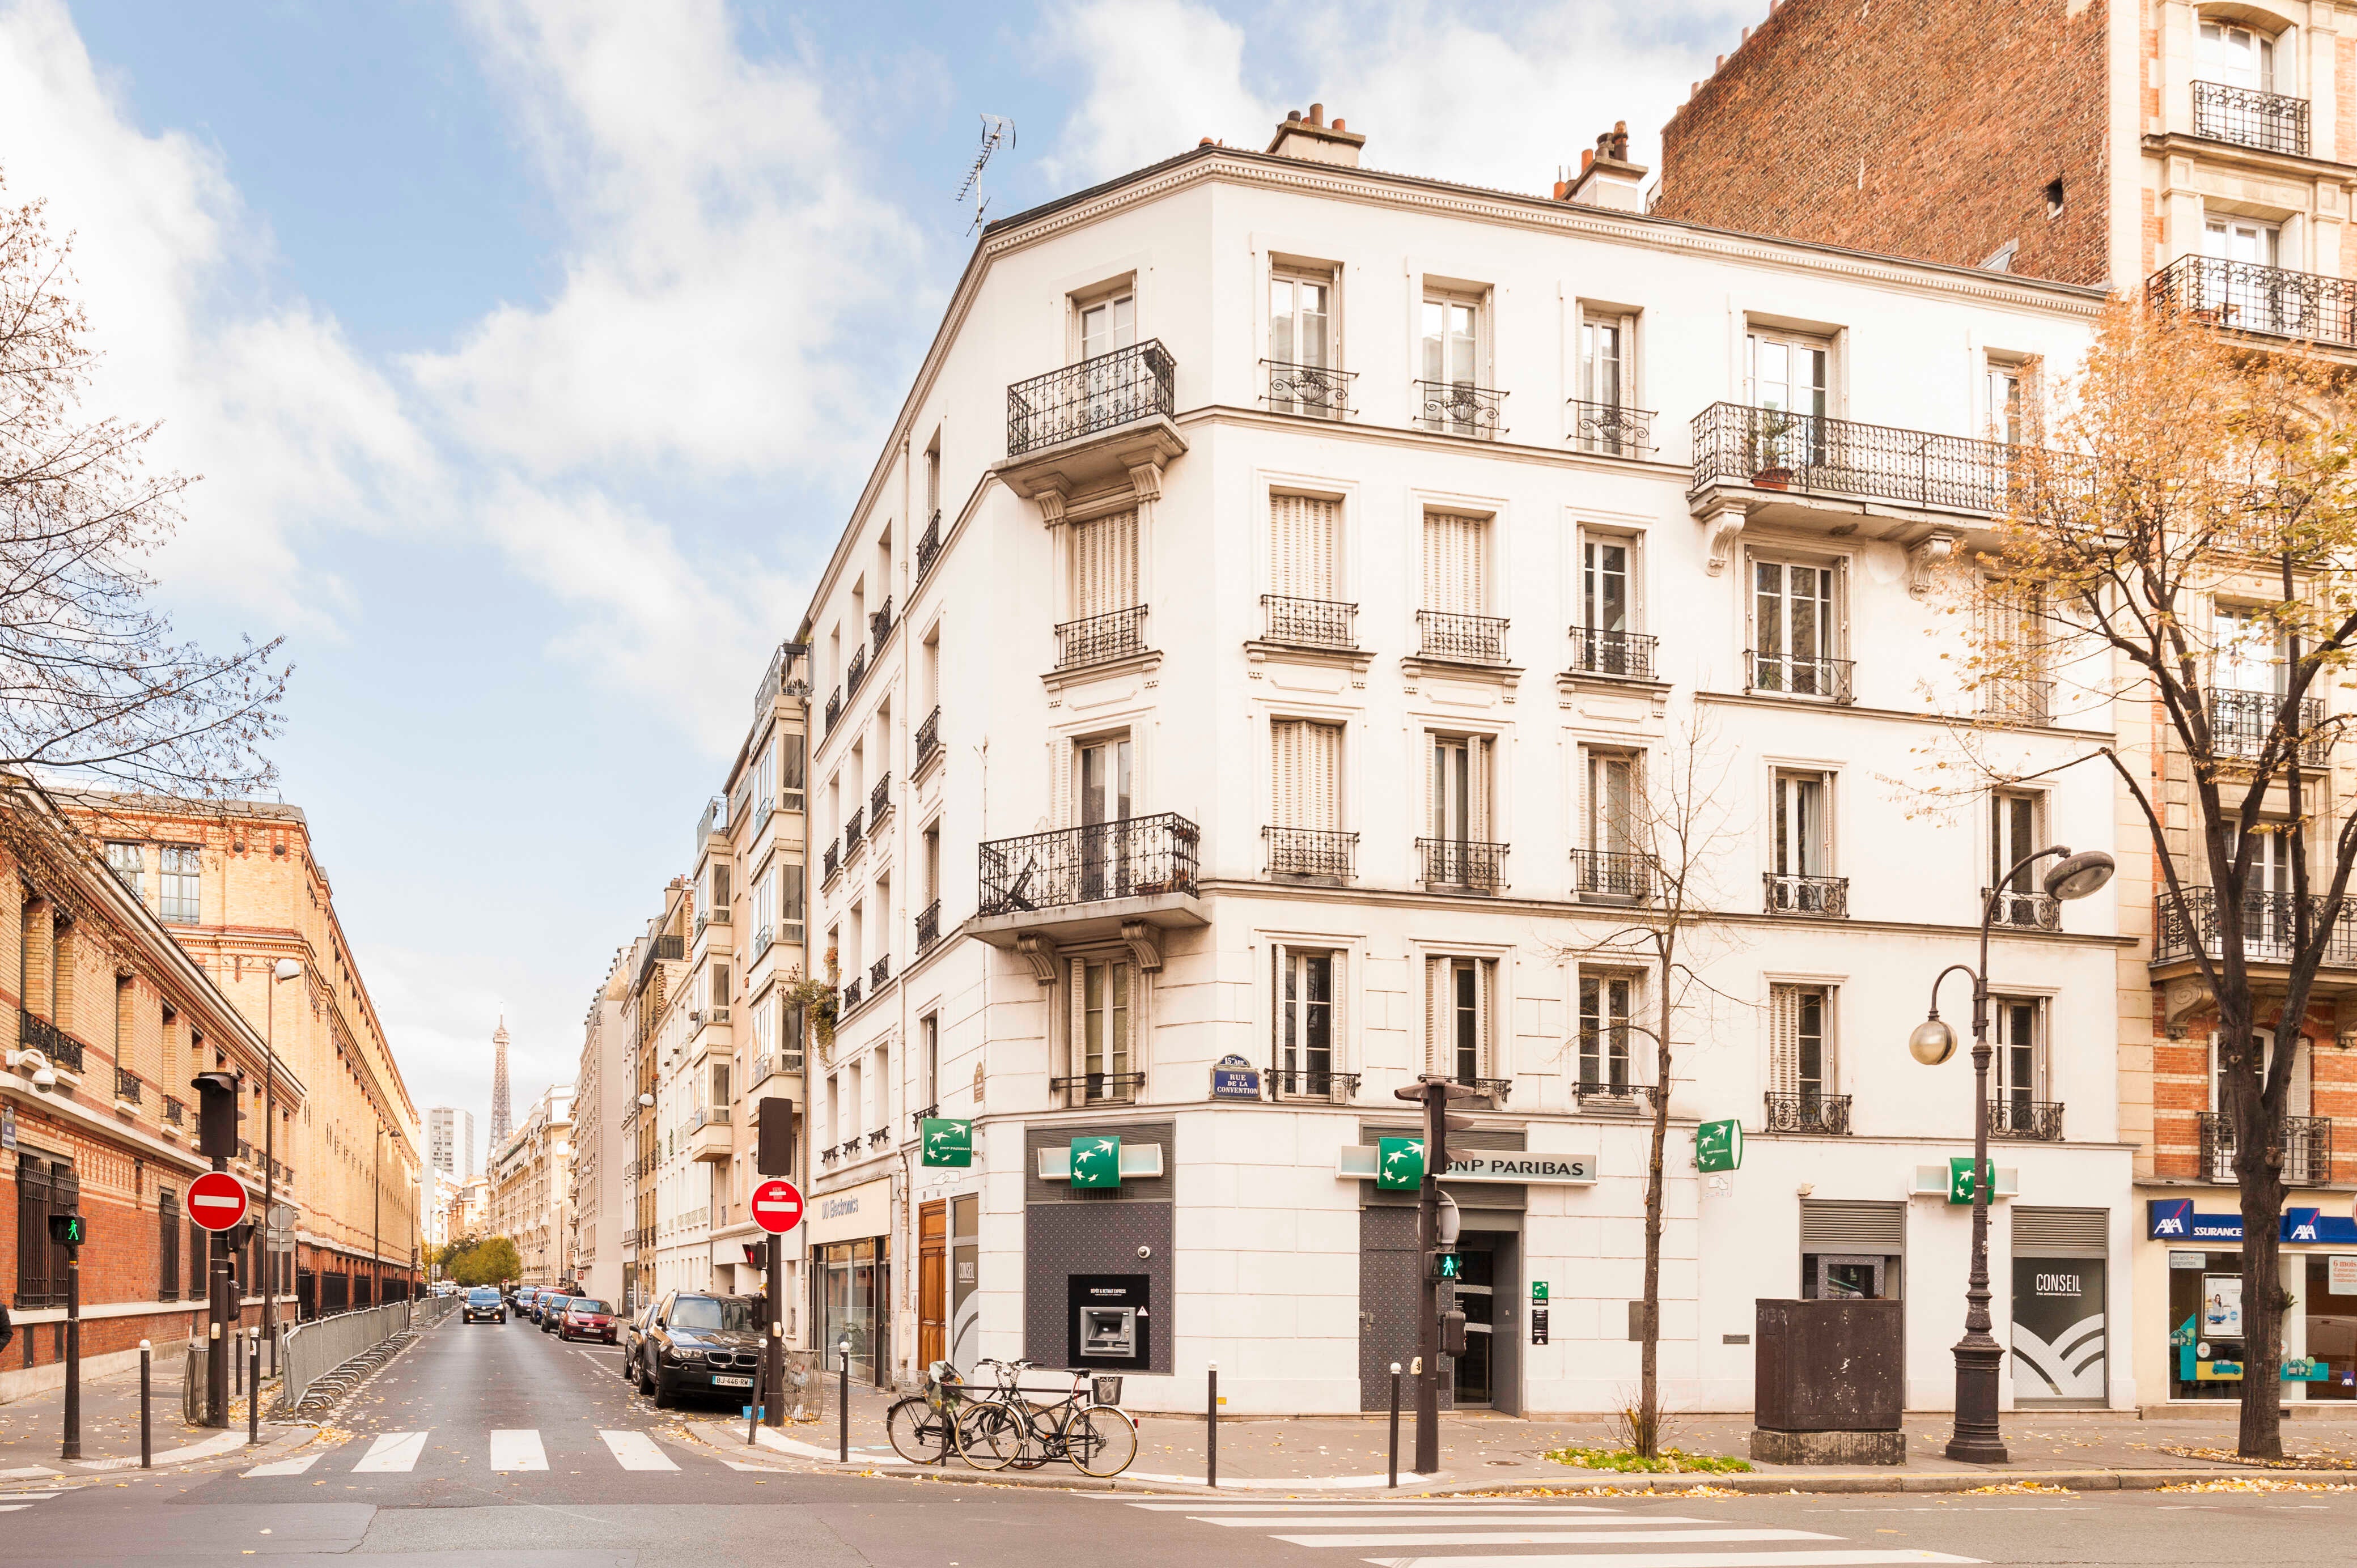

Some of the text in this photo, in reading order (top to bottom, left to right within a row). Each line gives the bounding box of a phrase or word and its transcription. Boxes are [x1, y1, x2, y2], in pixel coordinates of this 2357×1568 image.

[1491, 1160, 1584, 1176] PARIBAS
[2154, 1218, 2184, 1234] AXA
[2194, 1227, 2242, 1236] SSURANCE
[2291, 1225, 2317, 1239] AXA
[959, 1262, 975, 1279] CONSEIL
[2036, 1273, 2082, 1292] CONSEIL
